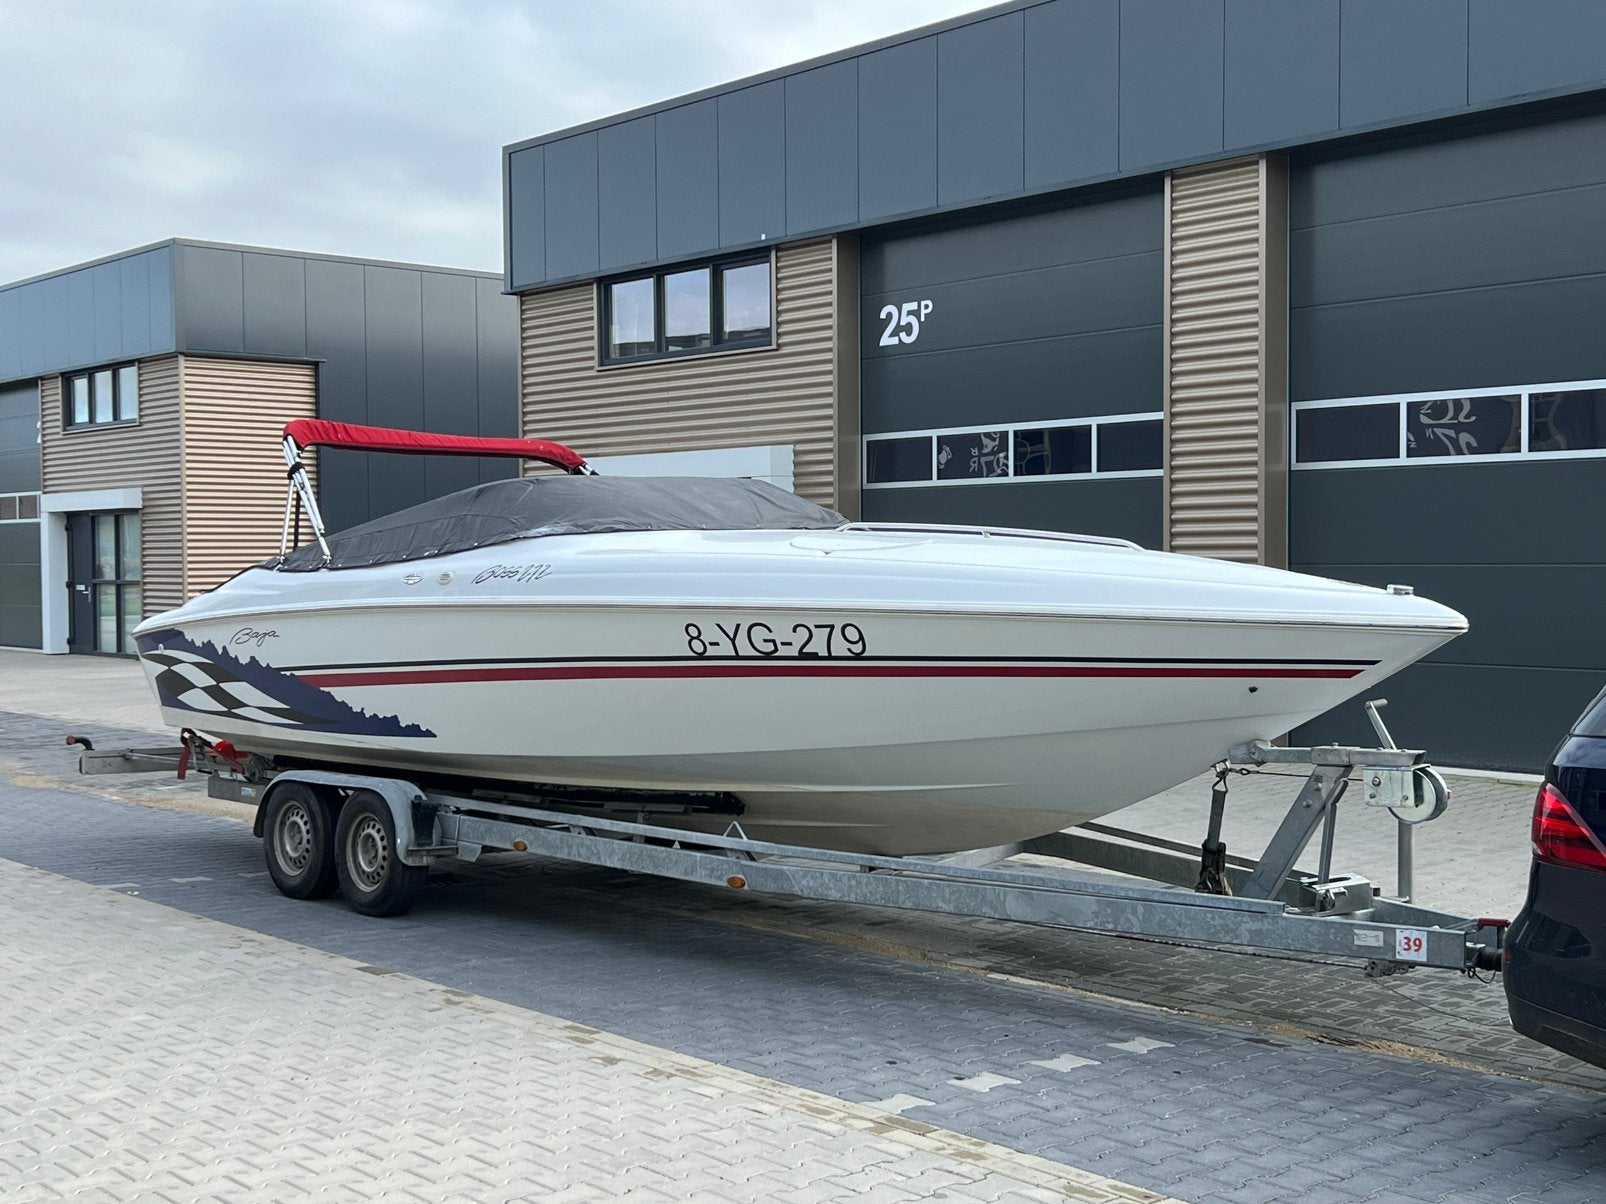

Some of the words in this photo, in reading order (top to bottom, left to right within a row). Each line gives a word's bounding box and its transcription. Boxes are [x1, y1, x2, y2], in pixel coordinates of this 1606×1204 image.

[229, 627, 281, 648] Baja
[684, 622, 867, 657] 8-YG-279
[1402, 936, 1423, 953] 39
